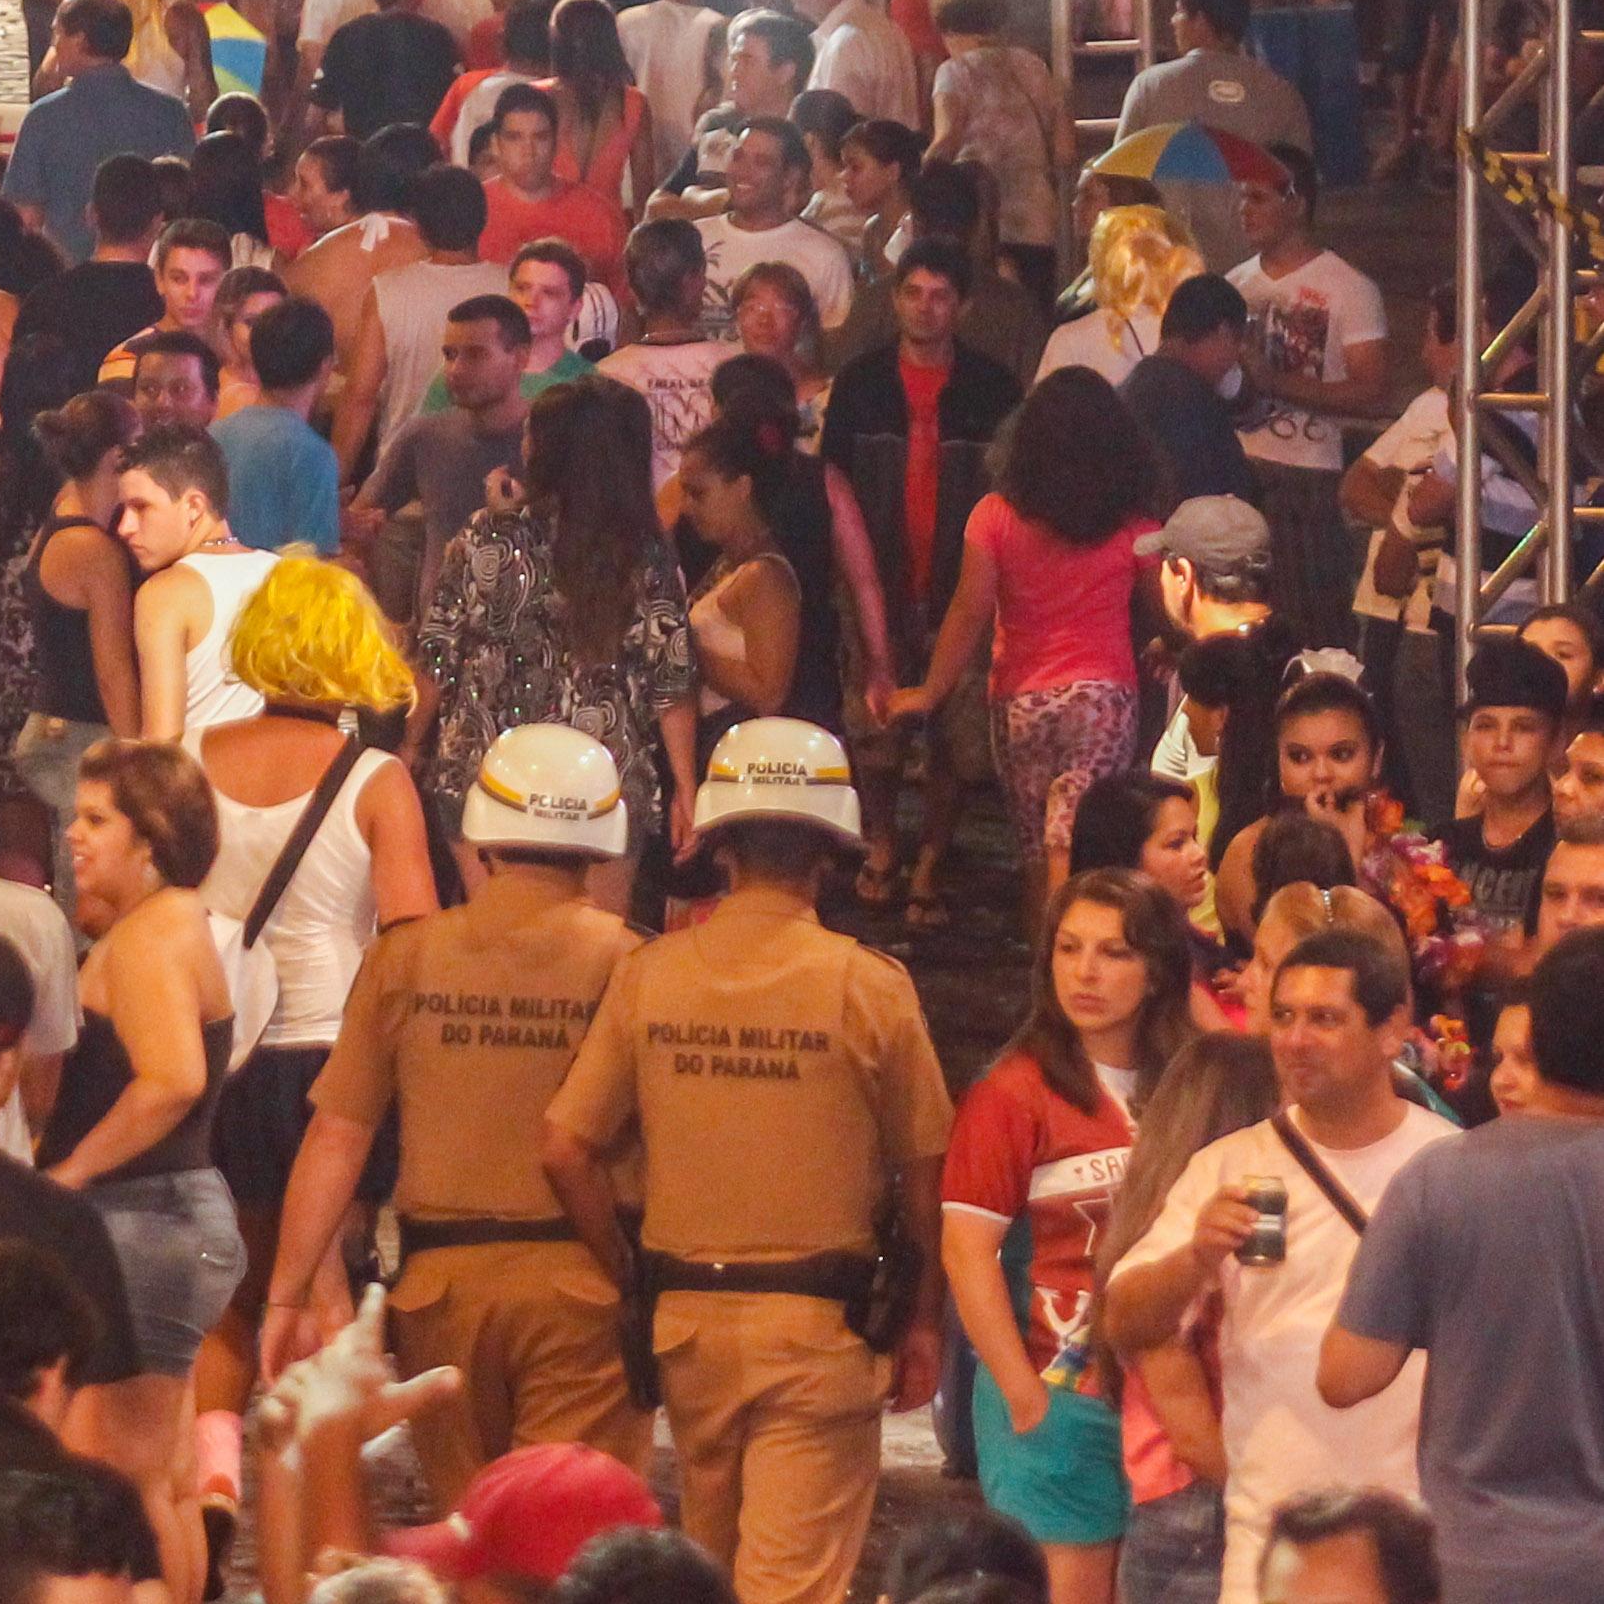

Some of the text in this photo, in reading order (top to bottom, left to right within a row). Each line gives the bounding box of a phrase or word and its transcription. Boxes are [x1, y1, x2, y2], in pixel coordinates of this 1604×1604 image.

[746, 762, 808, 777] POLICIA
[413, 990, 503, 1016] POLÍCIA
[440, 1020, 570, 1049] DO PARANÁ
[647, 1018, 830, 1052] POLÍCIA MILITAR
[673, 1052, 801, 1081] DO PARANÁ
